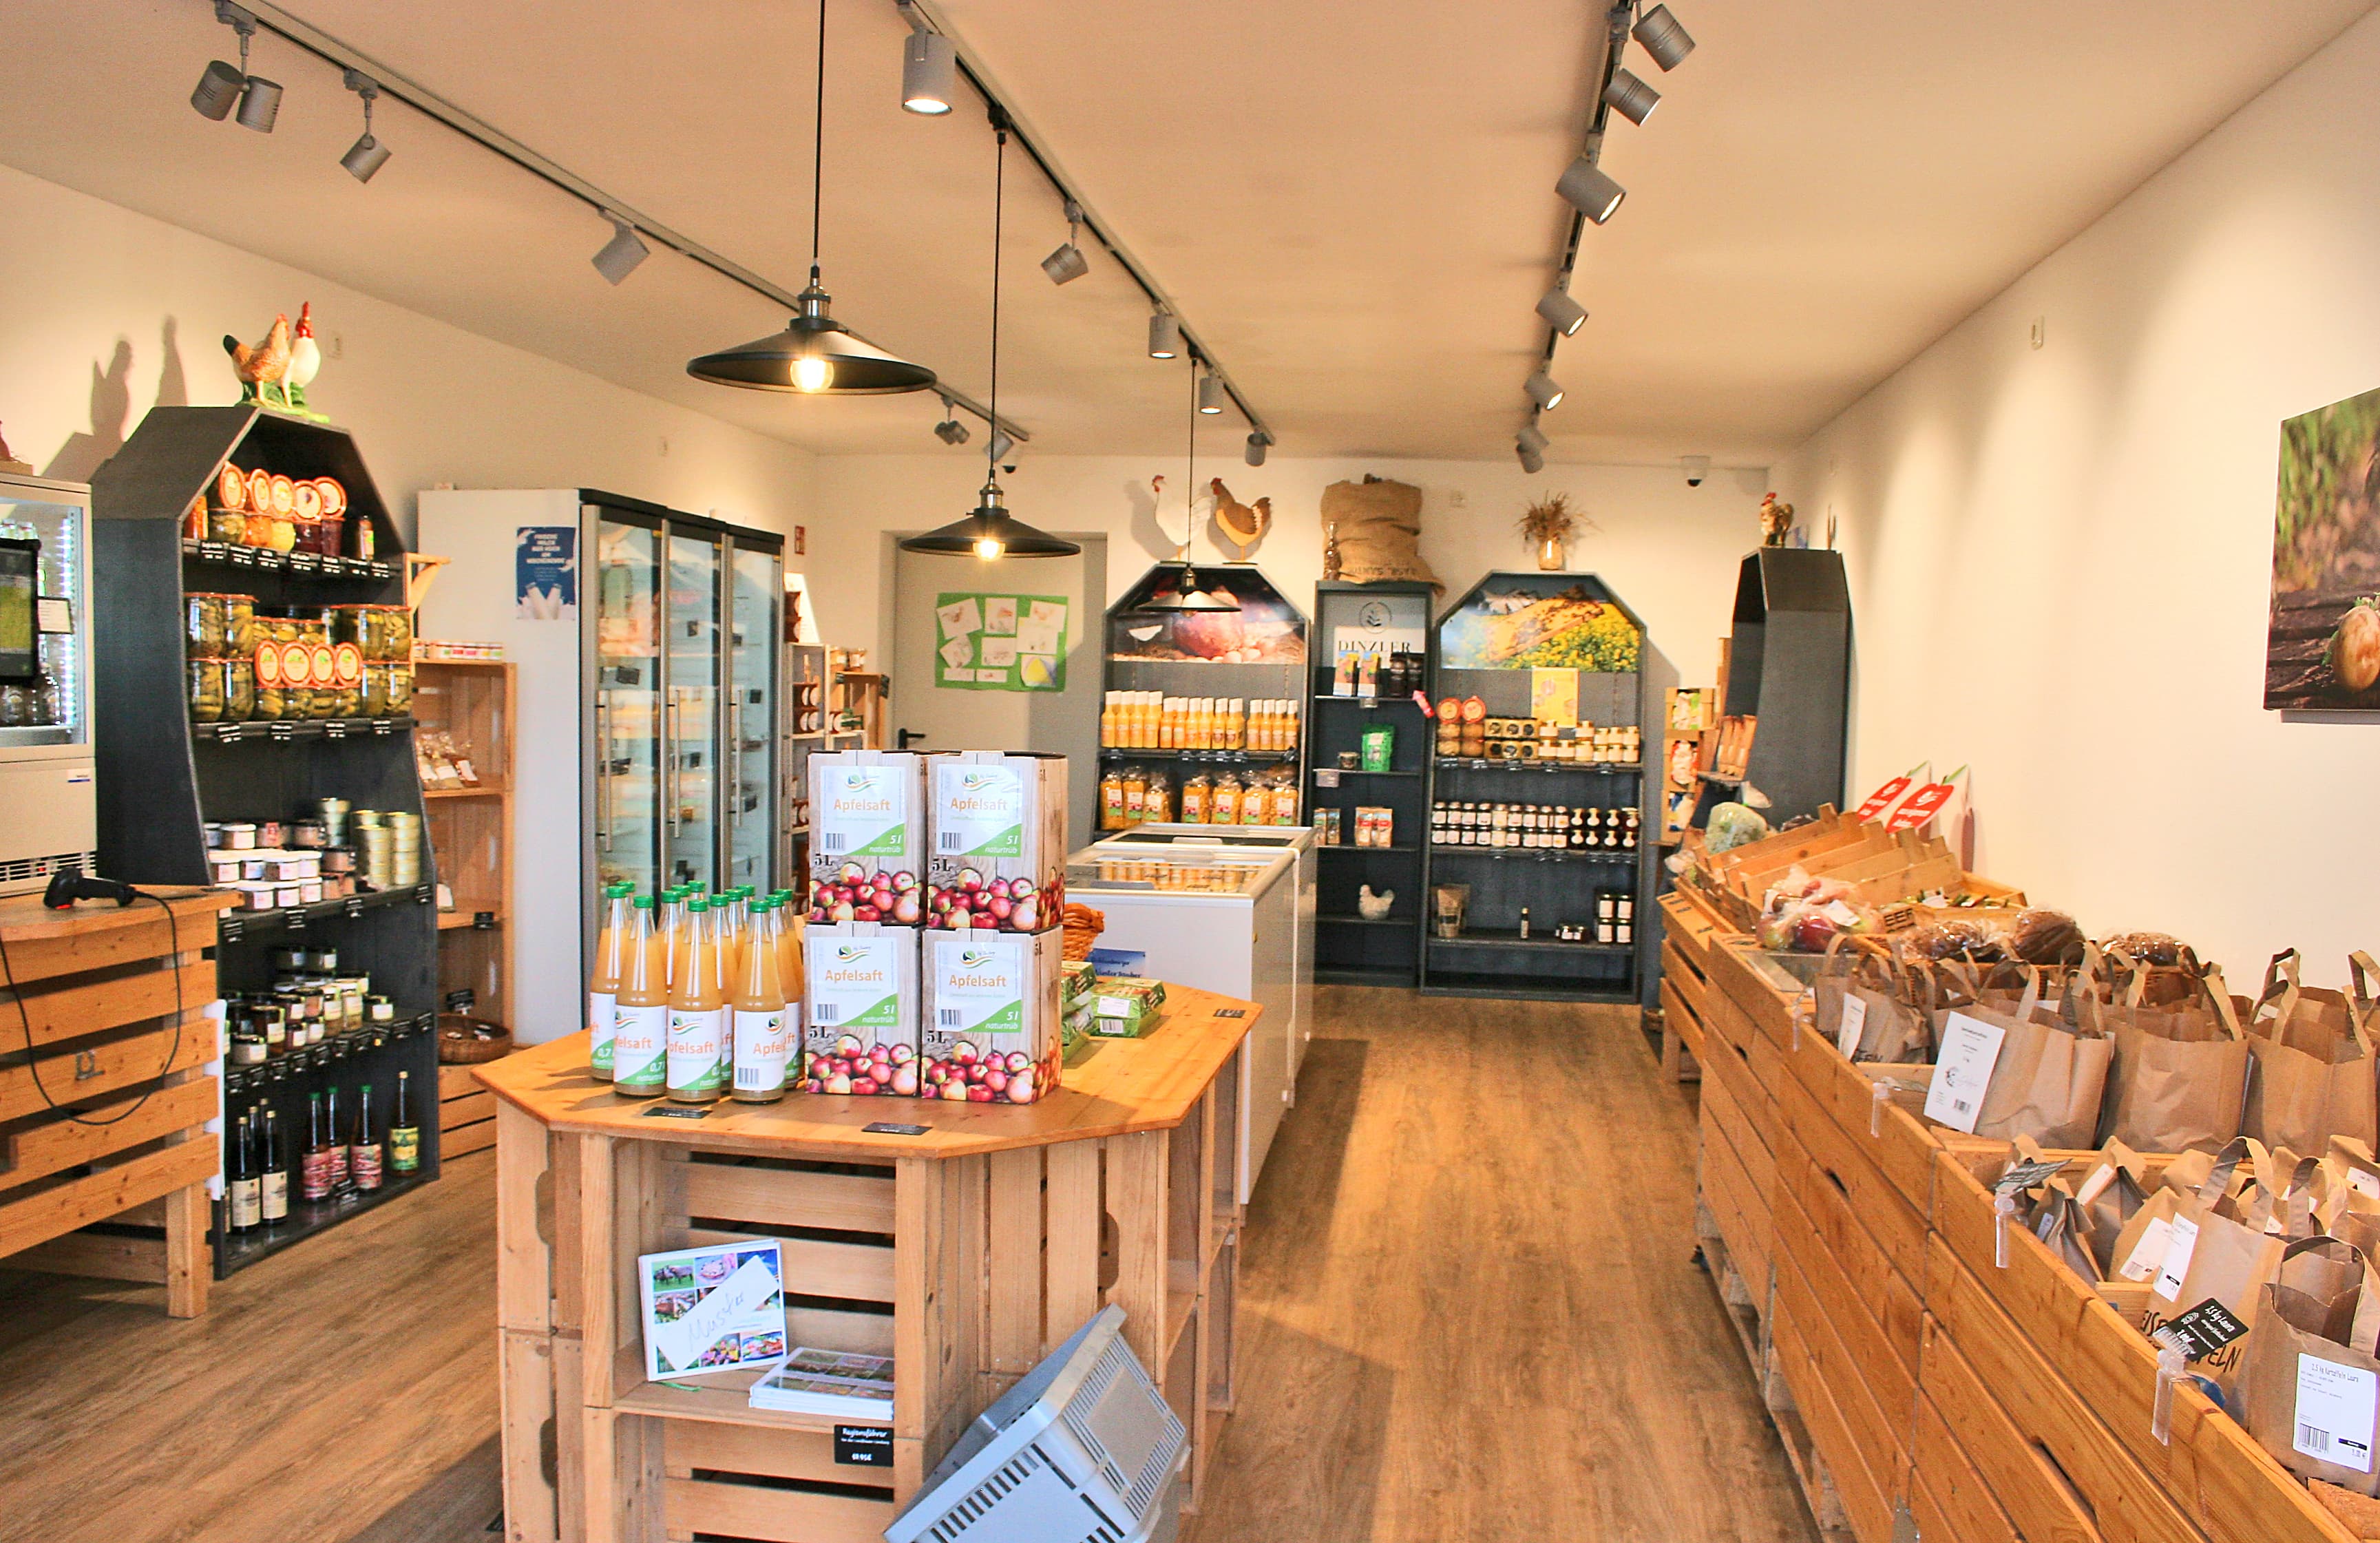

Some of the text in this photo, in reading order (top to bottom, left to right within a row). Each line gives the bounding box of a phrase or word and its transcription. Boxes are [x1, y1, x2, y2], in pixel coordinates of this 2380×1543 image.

[834, 799, 890, 812] Apfelsaft
[951, 797, 1007, 812] Apfelsaft
[825, 969, 883, 983] Apfelsaft
[949, 974, 1007, 989] Apfelsaft
[614, 1035, 653, 1049] felsaft
[668, 1041, 714, 1055] pfelsaft
